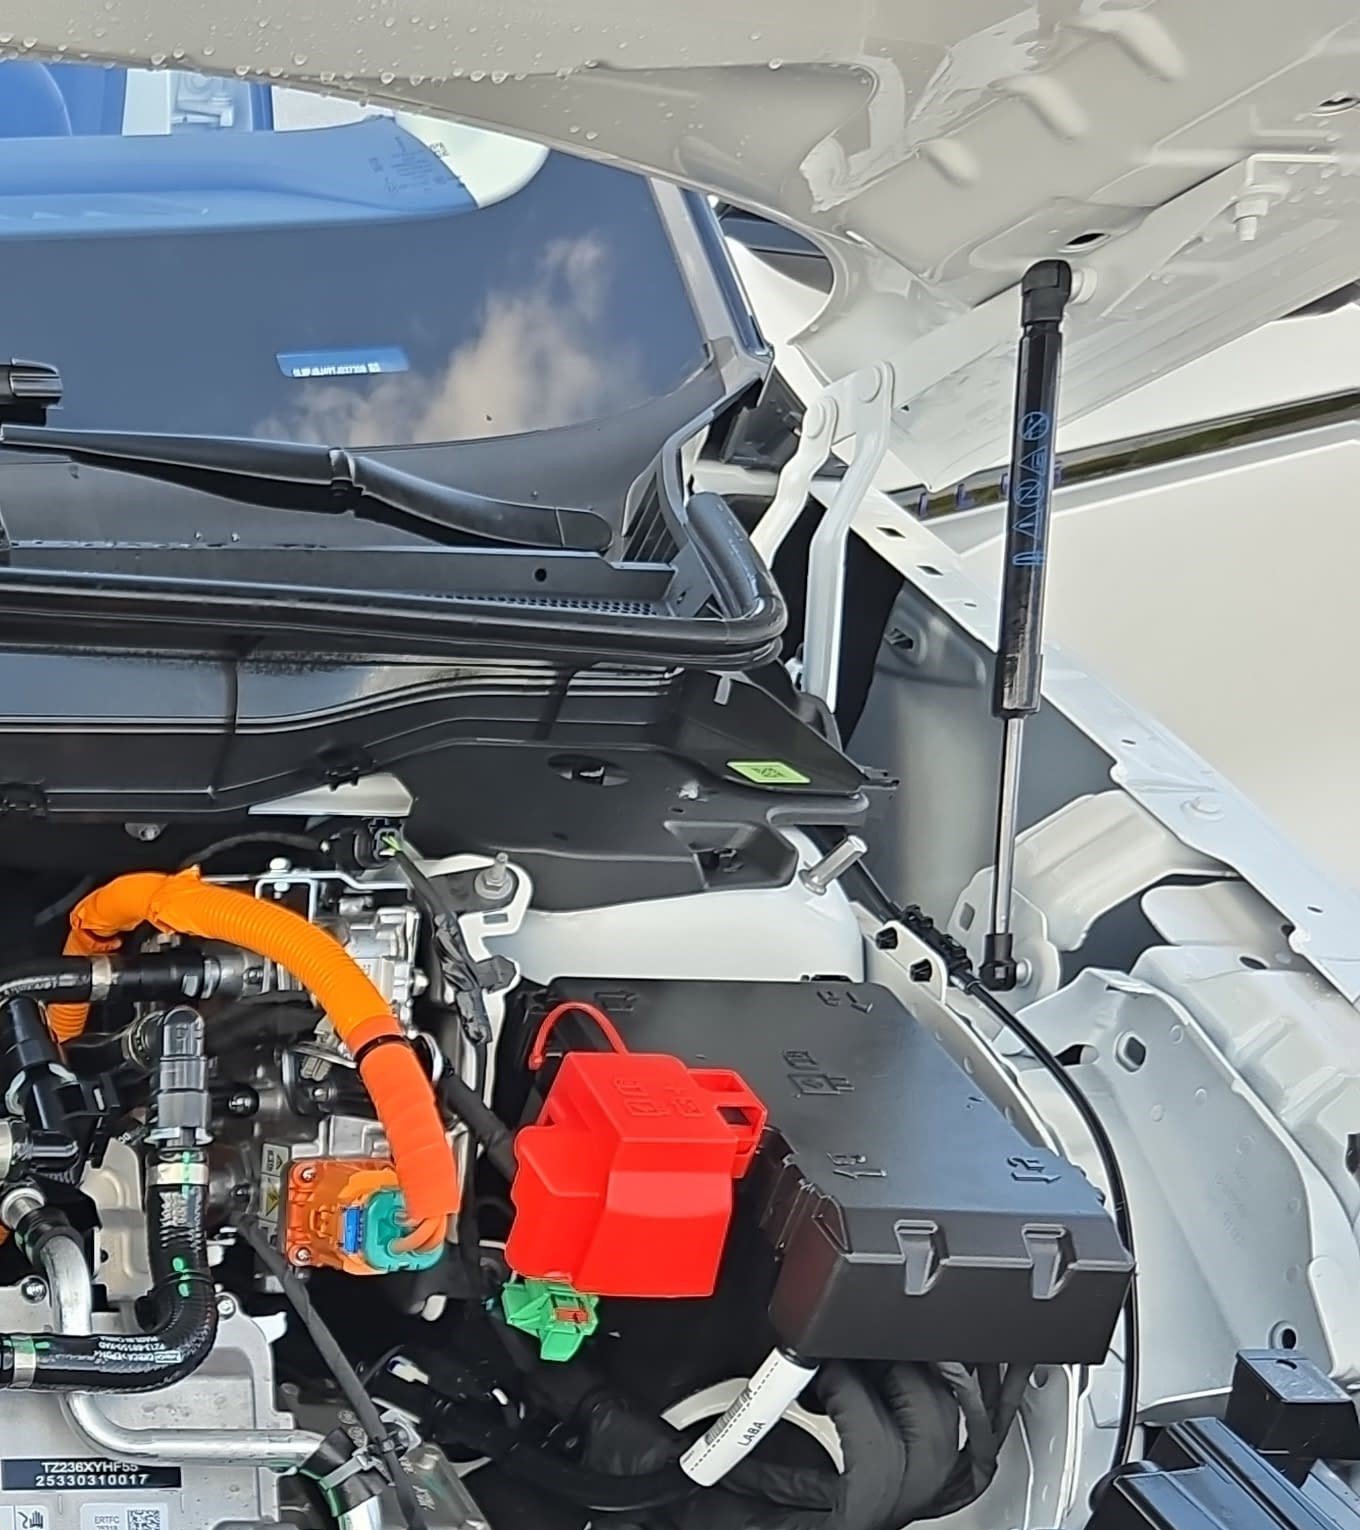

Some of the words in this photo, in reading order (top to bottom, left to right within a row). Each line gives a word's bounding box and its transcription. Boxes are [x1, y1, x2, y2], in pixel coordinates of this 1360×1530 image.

[737, 1421, 766, 1447] LABA
[41, 1462, 138, 1473] TZ236XYHF55
[36, 1474, 150, 1486] 25330310017
